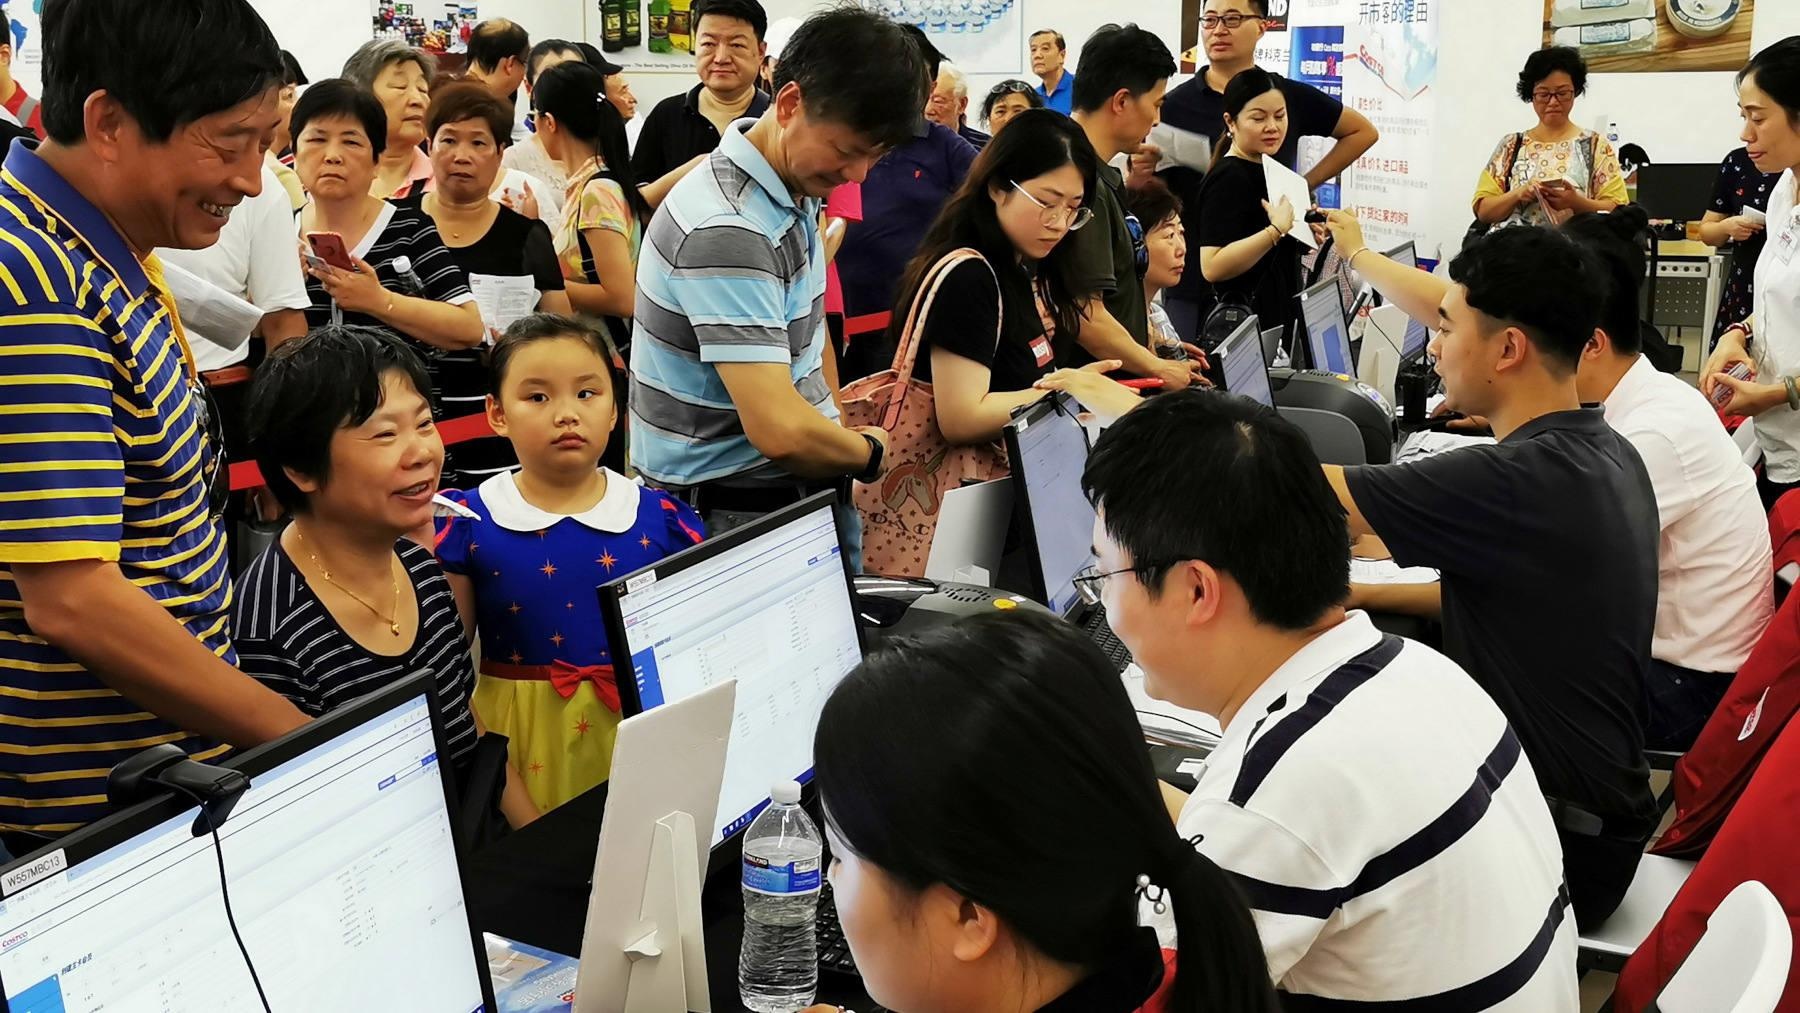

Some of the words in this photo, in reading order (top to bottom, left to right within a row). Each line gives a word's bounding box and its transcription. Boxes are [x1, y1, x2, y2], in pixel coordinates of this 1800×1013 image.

[1359, 1, 1428, 25] 开市客的理由
[7, 855, 61, 888] W557MBC13
